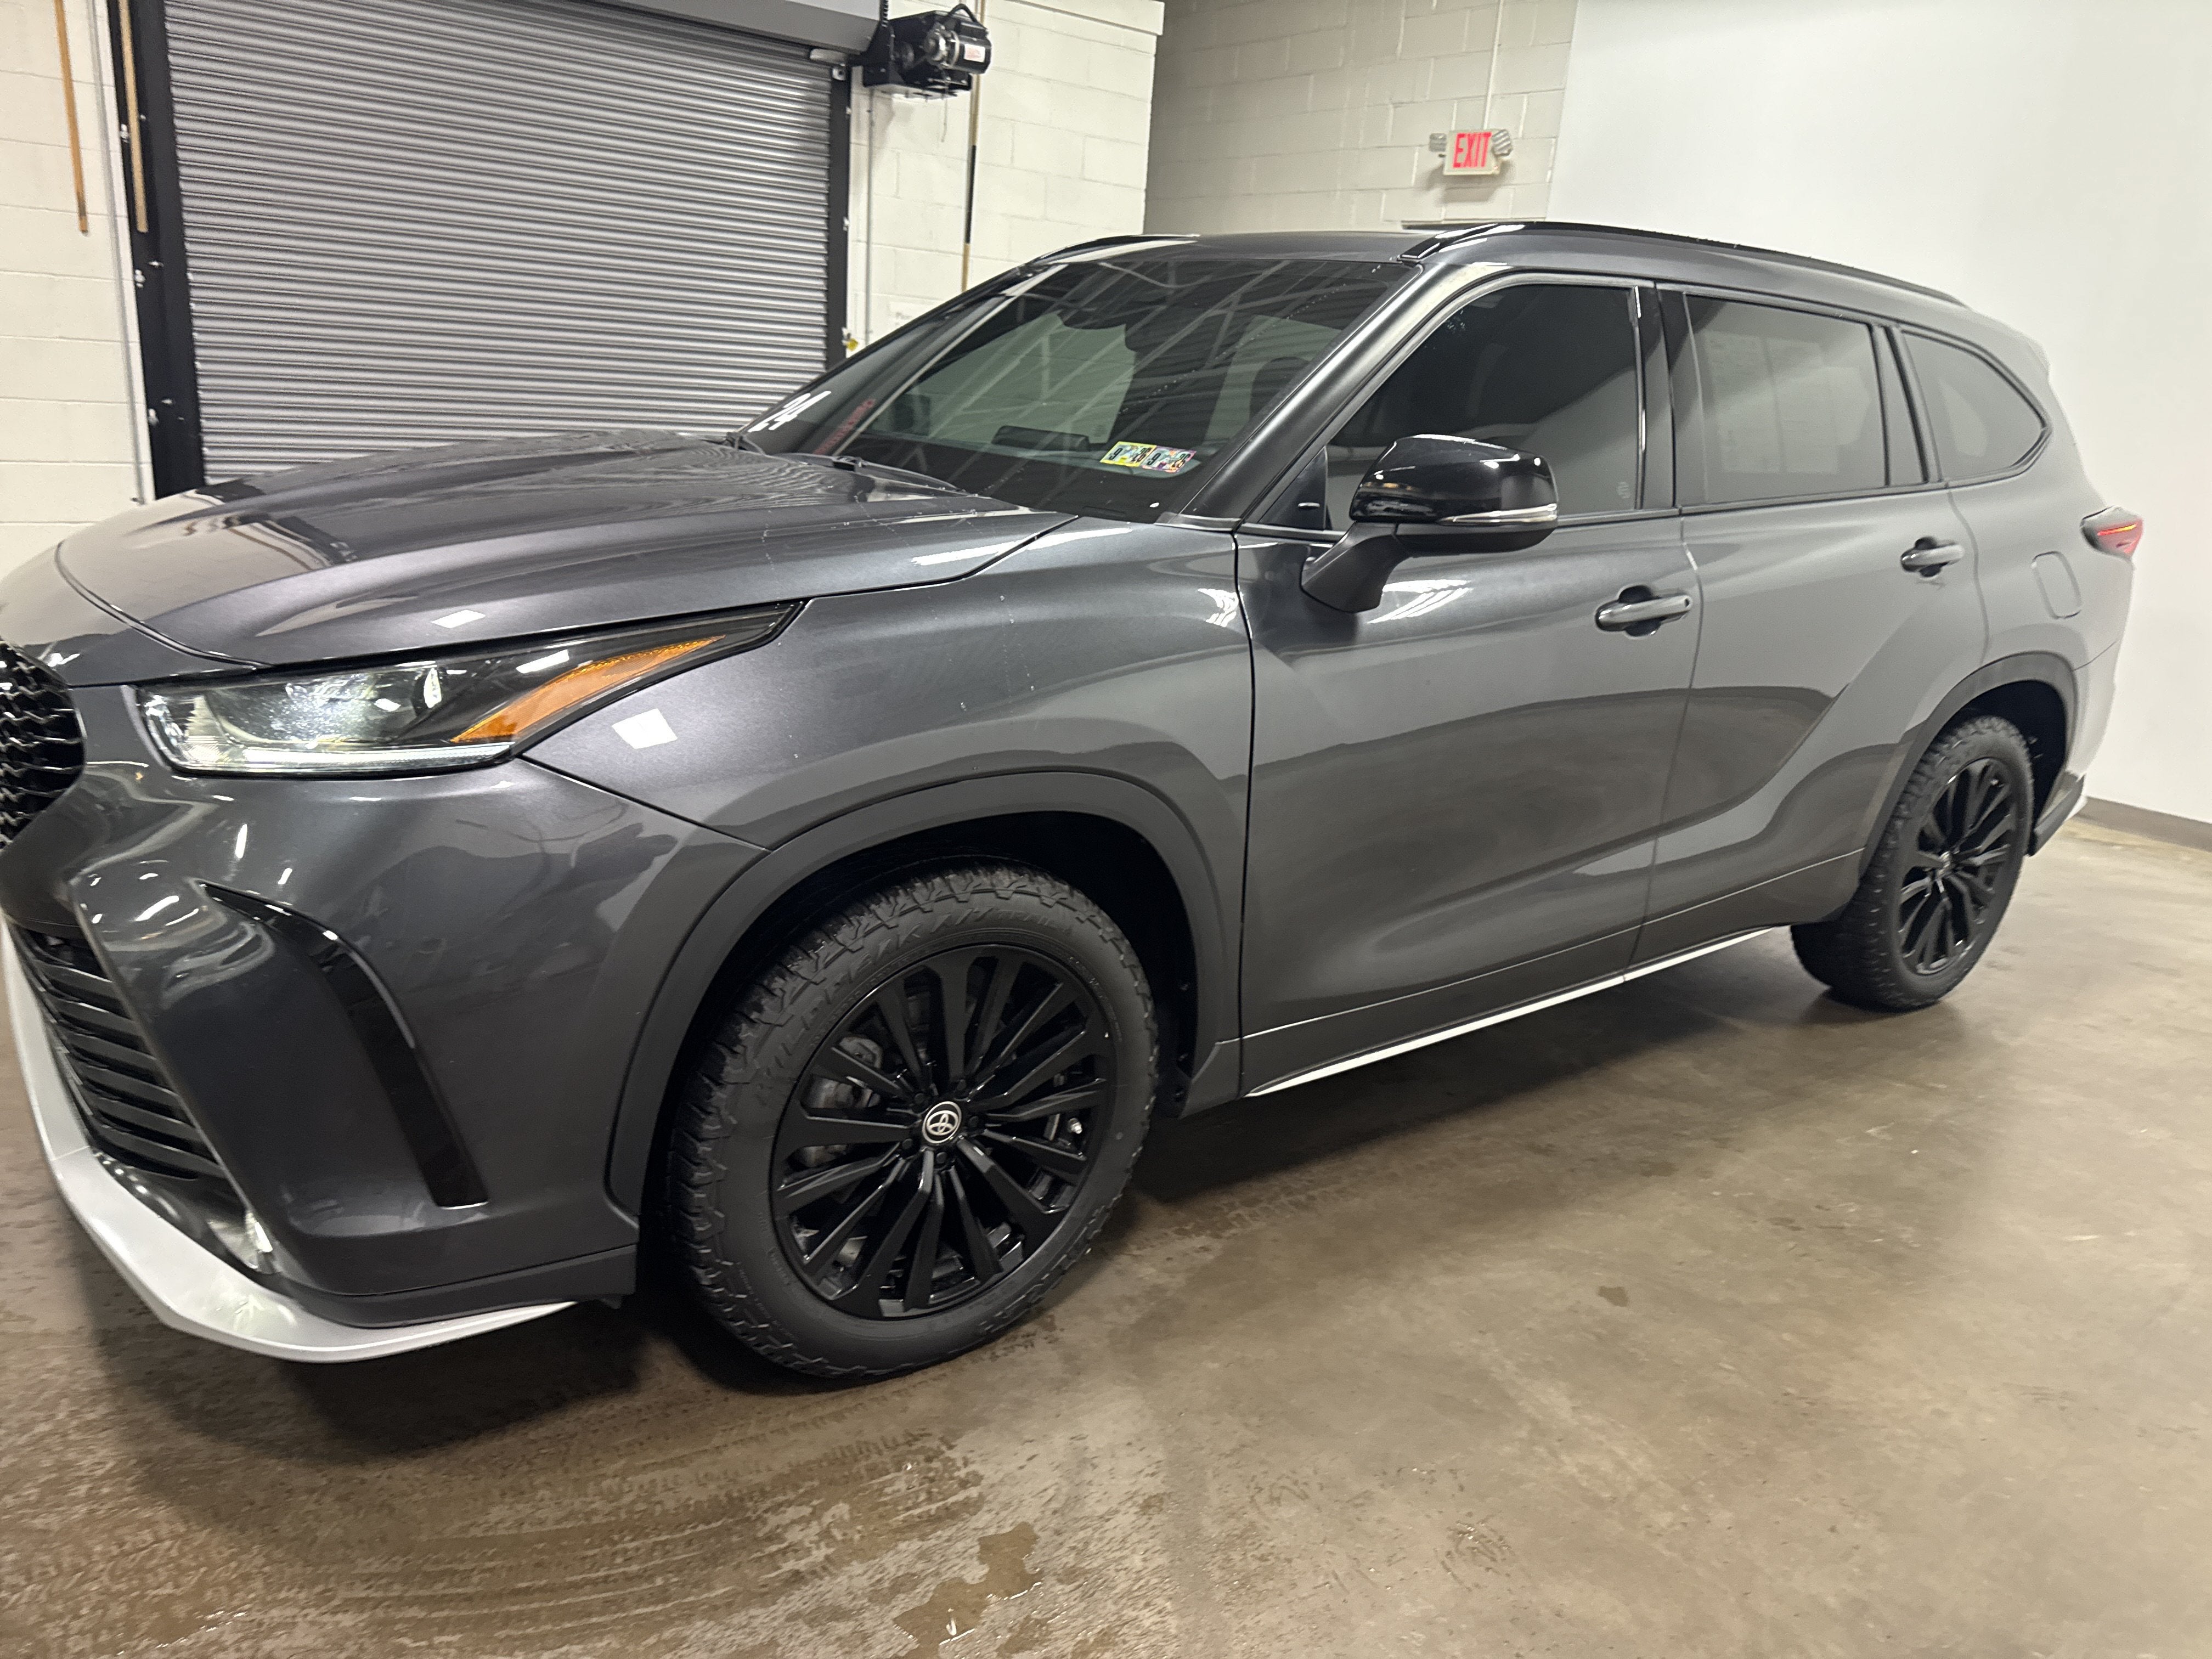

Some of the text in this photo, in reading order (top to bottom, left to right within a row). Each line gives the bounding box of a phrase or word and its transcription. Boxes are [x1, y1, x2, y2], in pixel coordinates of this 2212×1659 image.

[1453, 132, 1492, 167] EXIT
[747, 391, 832, 432] 24
[1109, 448, 1124, 460] 9
[1147, 453, 1161, 466] 9
